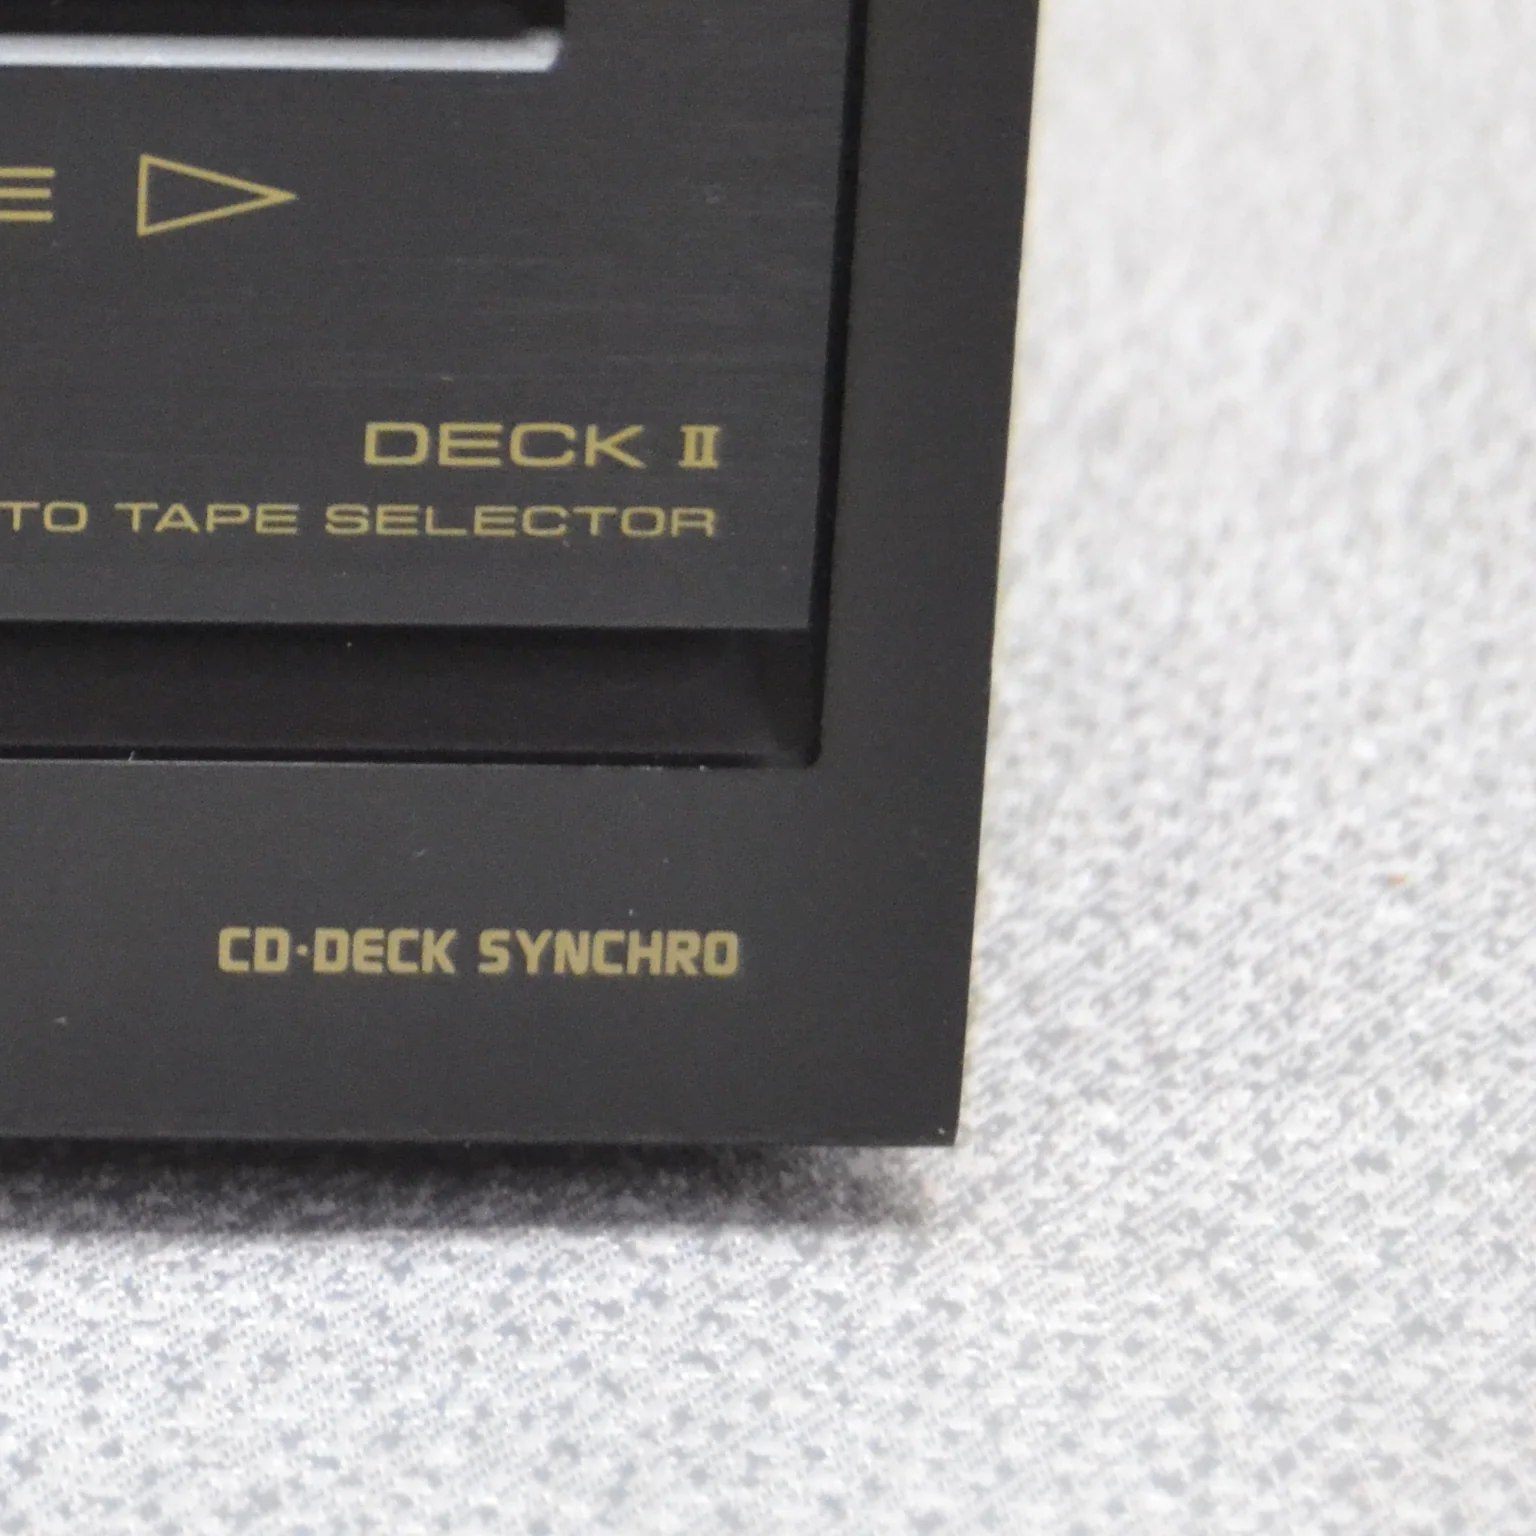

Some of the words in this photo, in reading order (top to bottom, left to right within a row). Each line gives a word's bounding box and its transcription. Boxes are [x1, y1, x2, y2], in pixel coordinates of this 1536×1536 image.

[363, 421, 644, 468] DECK
[114, 502, 299, 535] TAPE
[324, 503, 717, 538] SELECTOR
[478, 928, 740, 977] SYNCHRO
